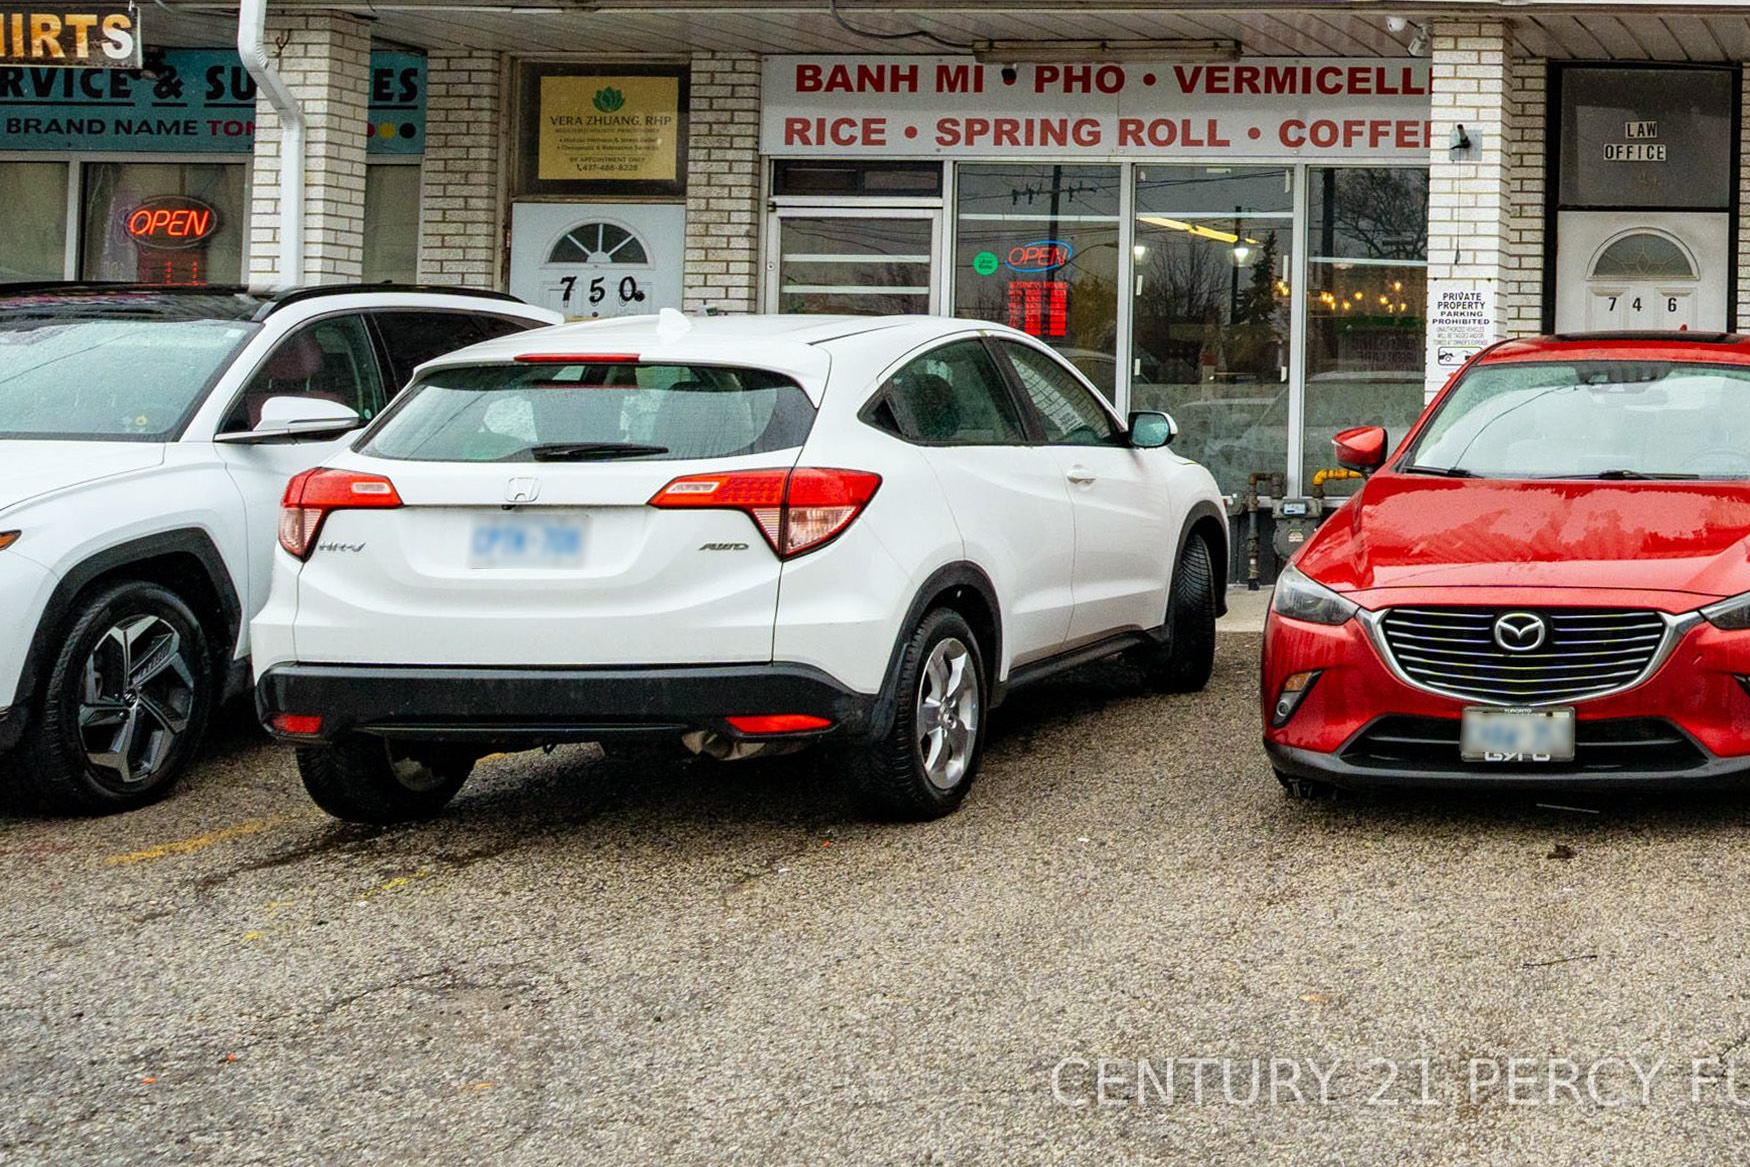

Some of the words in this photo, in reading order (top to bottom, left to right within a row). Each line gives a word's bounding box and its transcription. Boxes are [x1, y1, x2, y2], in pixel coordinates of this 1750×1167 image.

[153, 65, 184, 99] &
[795, 64, 919, 93] BANH
[935, 64, 985, 94] MI
[1034, 64, 1126, 94] PHO
[1173, 65, 1433, 96] VERMICELL
[6, 118, 106, 135] BRAND
[114, 120, 199, 136] NAME
[550, 116, 583, 126] VERA
[645, 116, 672, 126] RHP
[1626, 122, 1657, 138] LAW
[784, 117, 888, 147] RICE
[935, 117, 1102, 147] SPRING
[1118, 118, 1231, 148] ROLL
[1604, 145, 1665, 161] OFFICE
[130, 210, 209, 236] OPEN
[1008, 247, 1069, 265] OPEN
[560, 276, 638, 302] 750
[1442, 292, 1482, 301] PRIVATE
[1437, 301, 1486, 310] PROPERTY
[1608, 297, 1677, 312] 746
